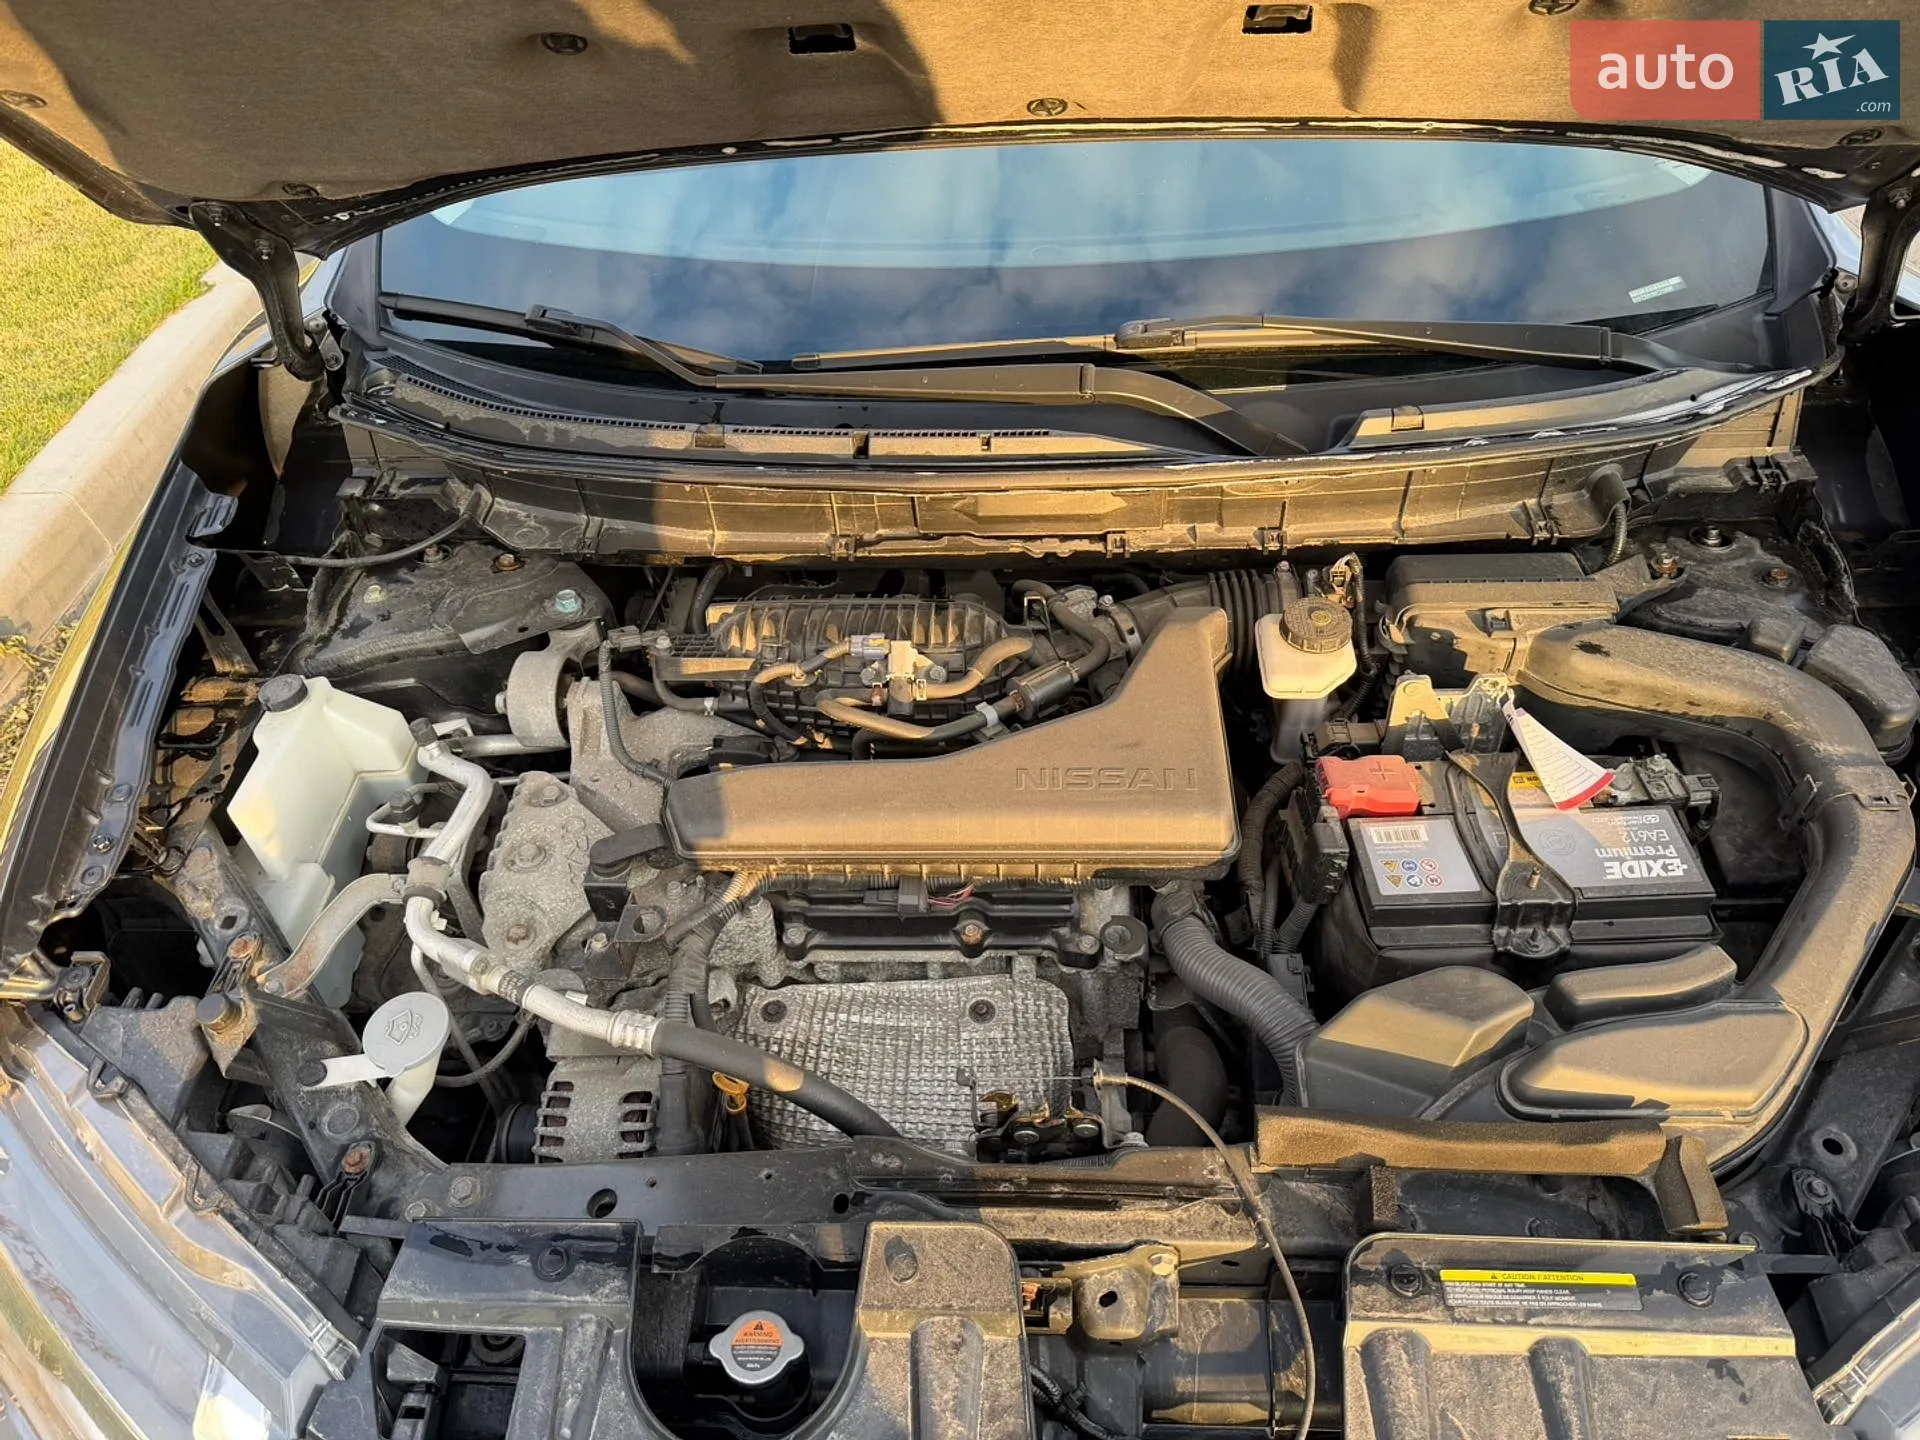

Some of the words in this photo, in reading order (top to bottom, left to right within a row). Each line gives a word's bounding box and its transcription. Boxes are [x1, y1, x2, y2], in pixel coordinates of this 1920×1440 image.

[1015, 767, 1198, 791] NISSAN
[1619, 829, 1669, 843] EA612
[1594, 844, 1678, 860] Premium
[1604, 858, 1687, 880] EXIDE
[1543, 1273, 1584, 1281] ATTENTION
